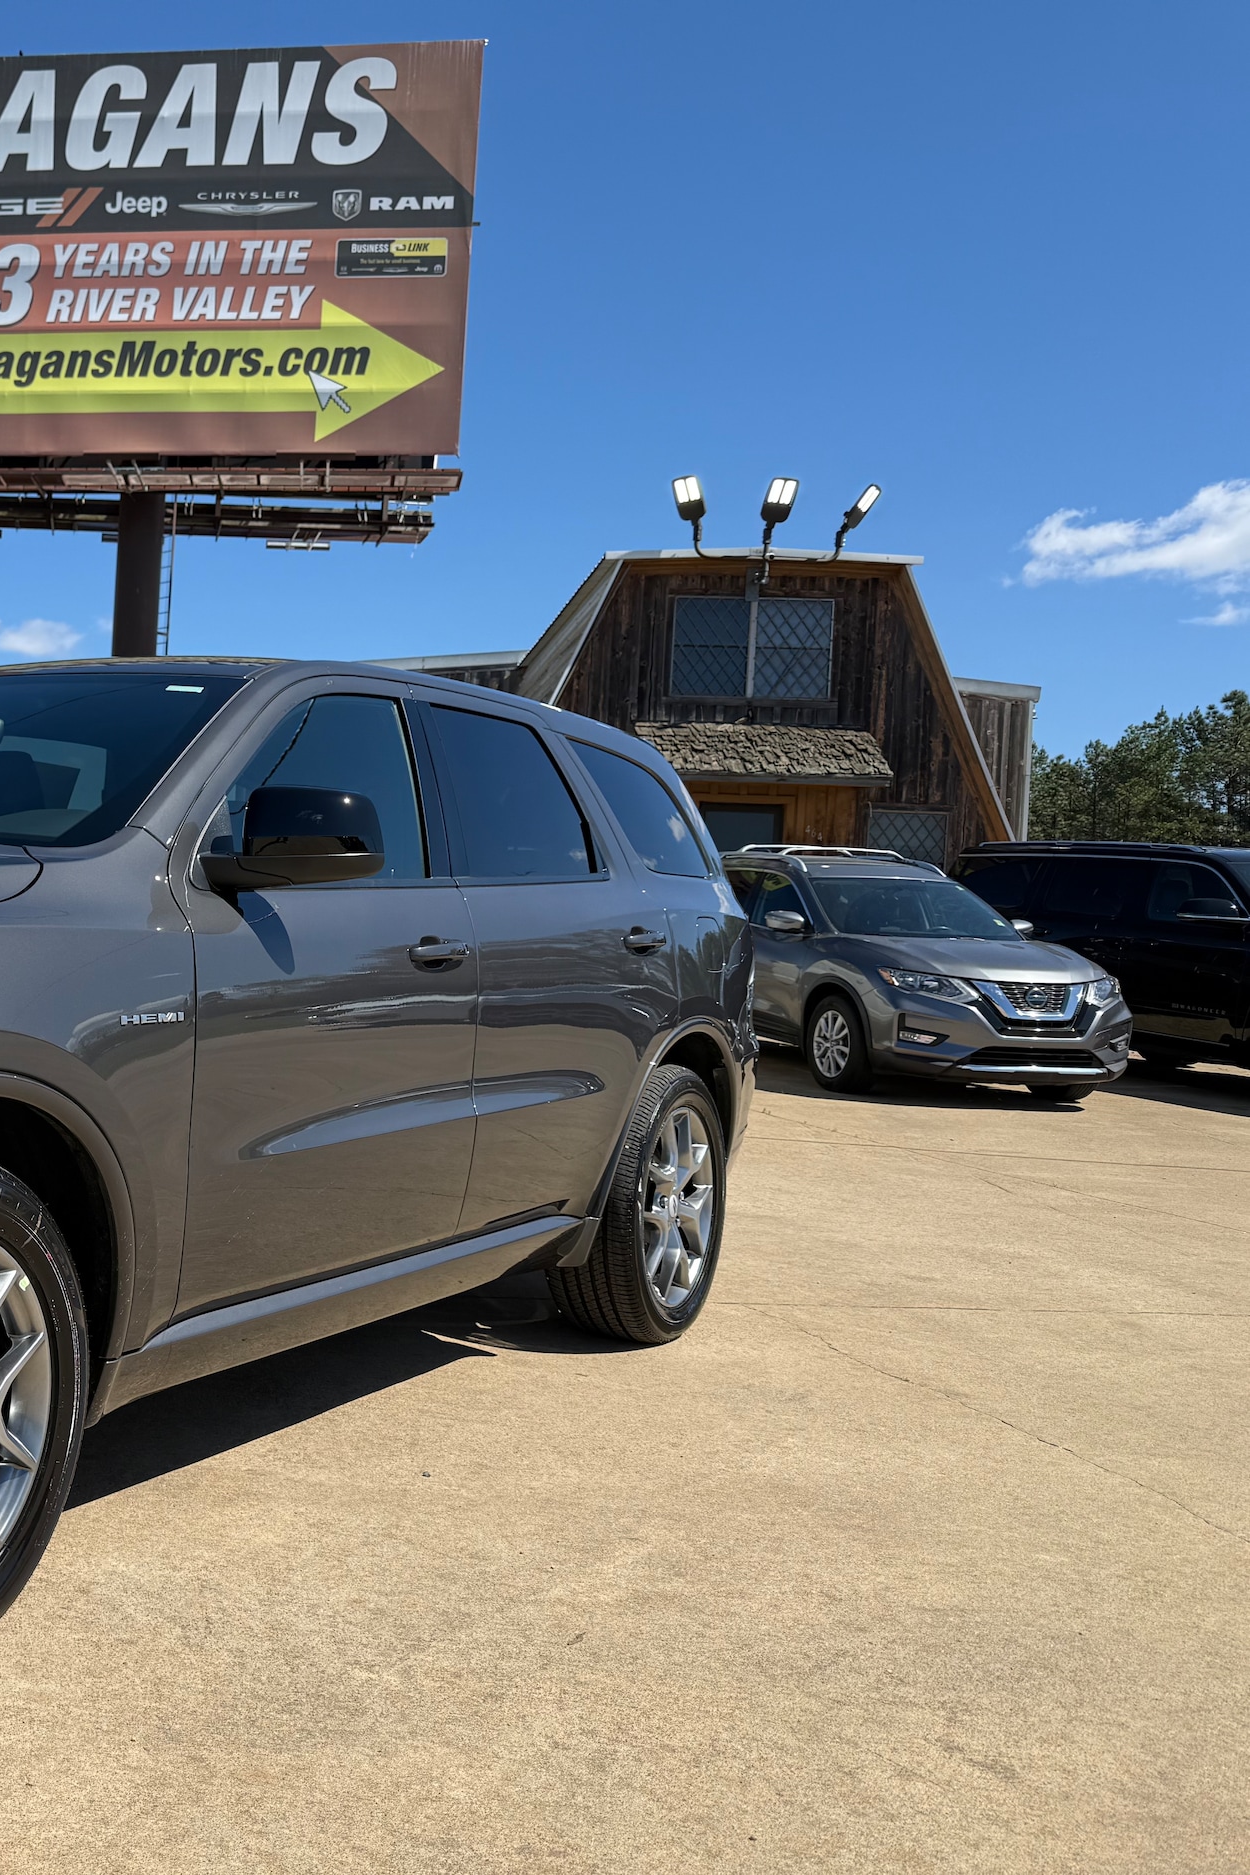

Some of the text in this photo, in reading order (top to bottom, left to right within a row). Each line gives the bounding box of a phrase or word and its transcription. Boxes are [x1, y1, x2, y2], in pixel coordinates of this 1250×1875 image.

[105, 191, 168, 217] Jeep
[196, 191, 300, 200] CHRYSLER
[369, 196, 455, 211] RAM
[53, 239, 313, 278] YEARS IN THE
[407, 242, 430, 252] LINK
[45, 285, 316, 323] RIVER VALLEY
[120, 1011, 186, 1026] HEMI
